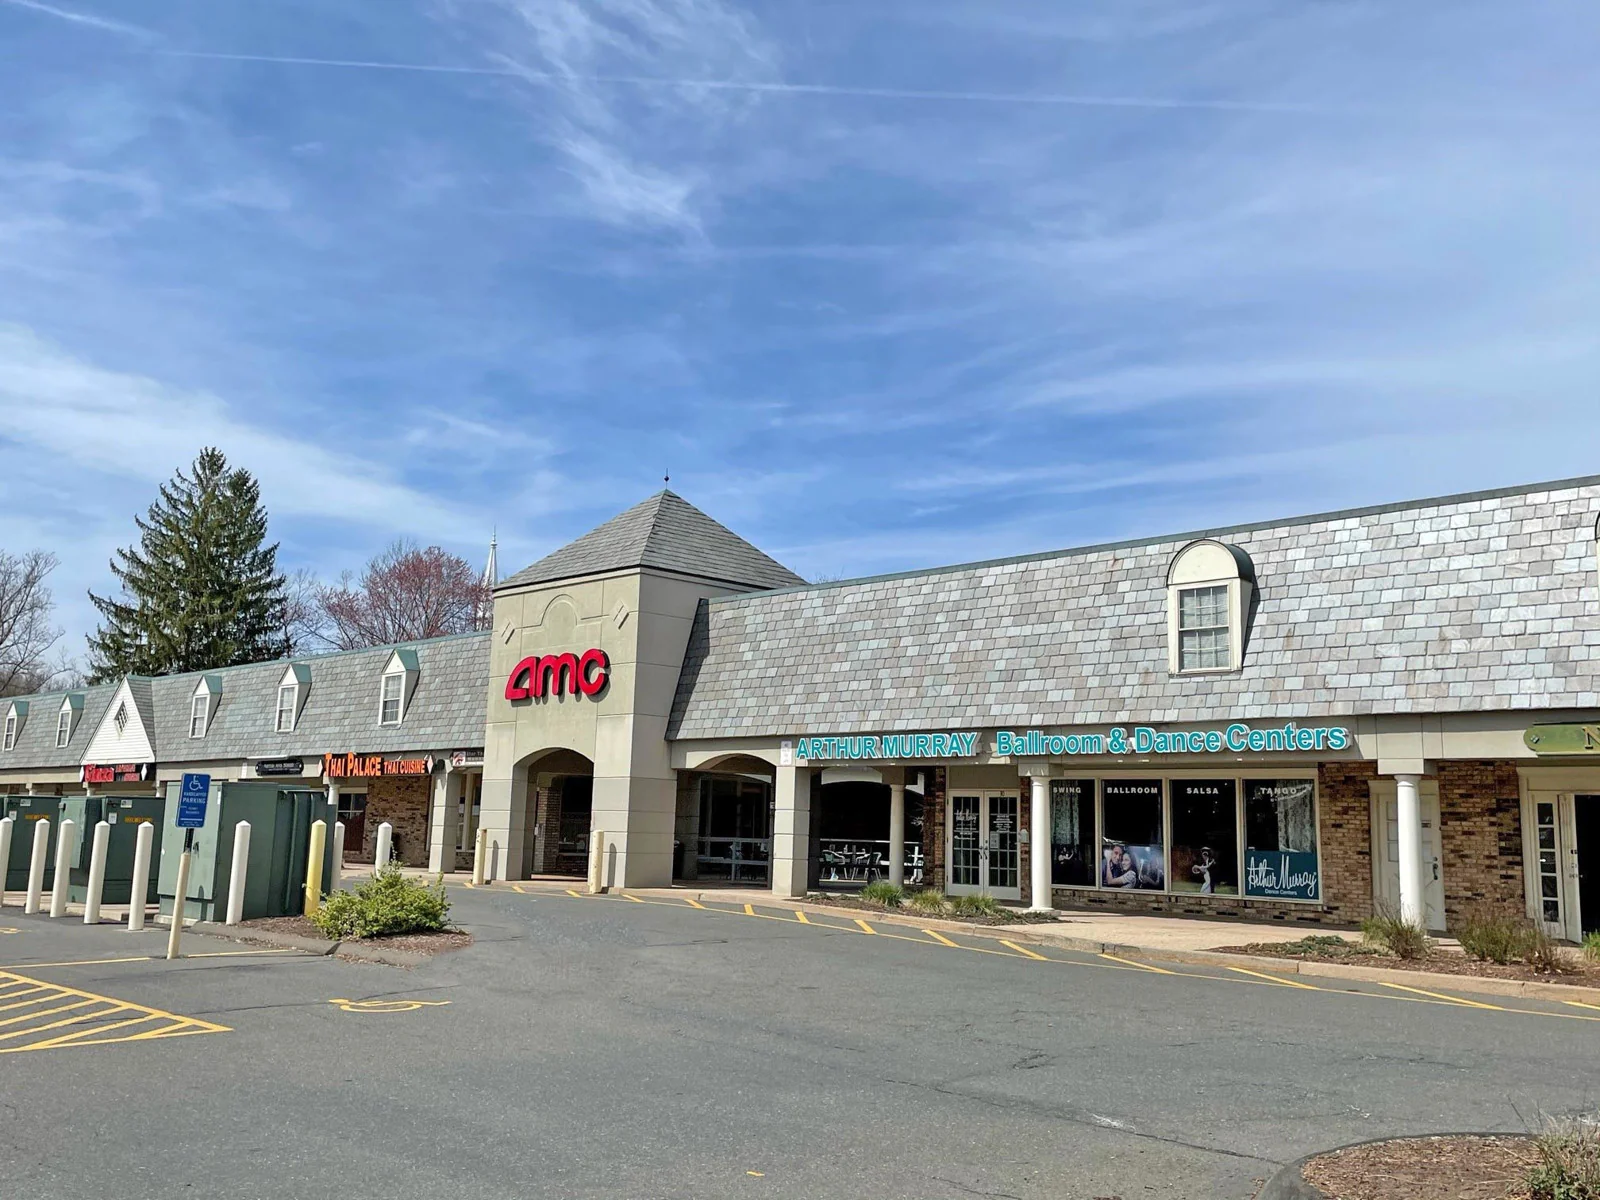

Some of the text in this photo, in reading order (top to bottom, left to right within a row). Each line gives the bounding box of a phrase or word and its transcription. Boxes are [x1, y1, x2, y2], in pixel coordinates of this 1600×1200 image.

[796, 736, 878, 760] ARTHUR
[883, 732, 978, 758] MURRAY
[997, 731, 1103, 755] Ballroom
[1109, 728, 1127, 754] &
[1135, 727, 1221, 753] Dance
[1227, 722, 1348, 750] Centers
[384, 760, 399, 774] THAI
[400, 759, 425, 774] CUISINE
[1260, 787, 1297, 795] TANGO
[1247, 854, 1317, 897] Arthur Murray
